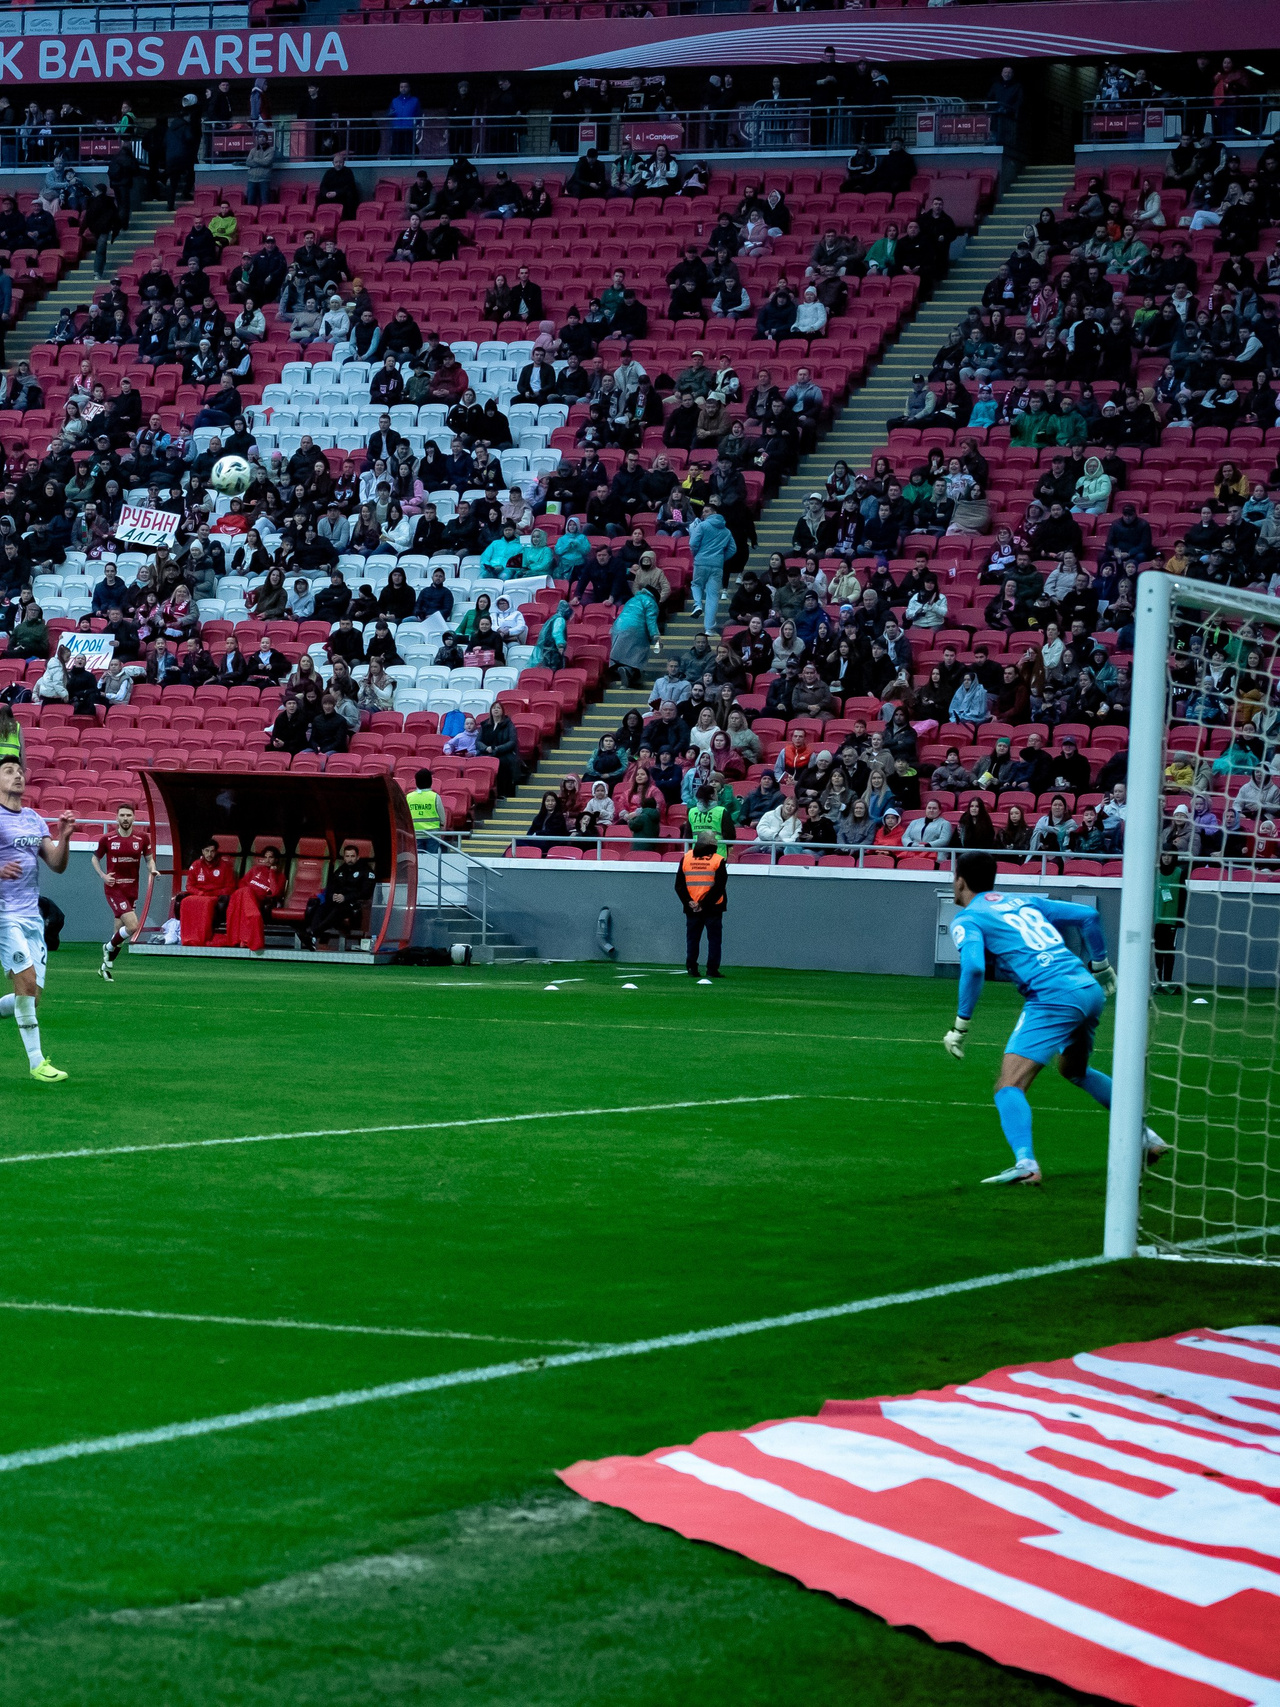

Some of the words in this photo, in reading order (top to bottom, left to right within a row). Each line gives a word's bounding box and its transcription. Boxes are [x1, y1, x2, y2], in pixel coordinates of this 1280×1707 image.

[39, 37, 165, 79] BARS
[177, 31, 349, 76] ARENA
[120, 506, 177, 533] РУБИН
[120, 528, 168, 544] АЛГА
[65, 634, 106, 653] АКРОН
[409, 803, 432, 811] STEWARD
[694, 812, 713, 823] 7175
[13, 836, 43, 848] FONBE
[1002, 906, 1065, 952] 88
